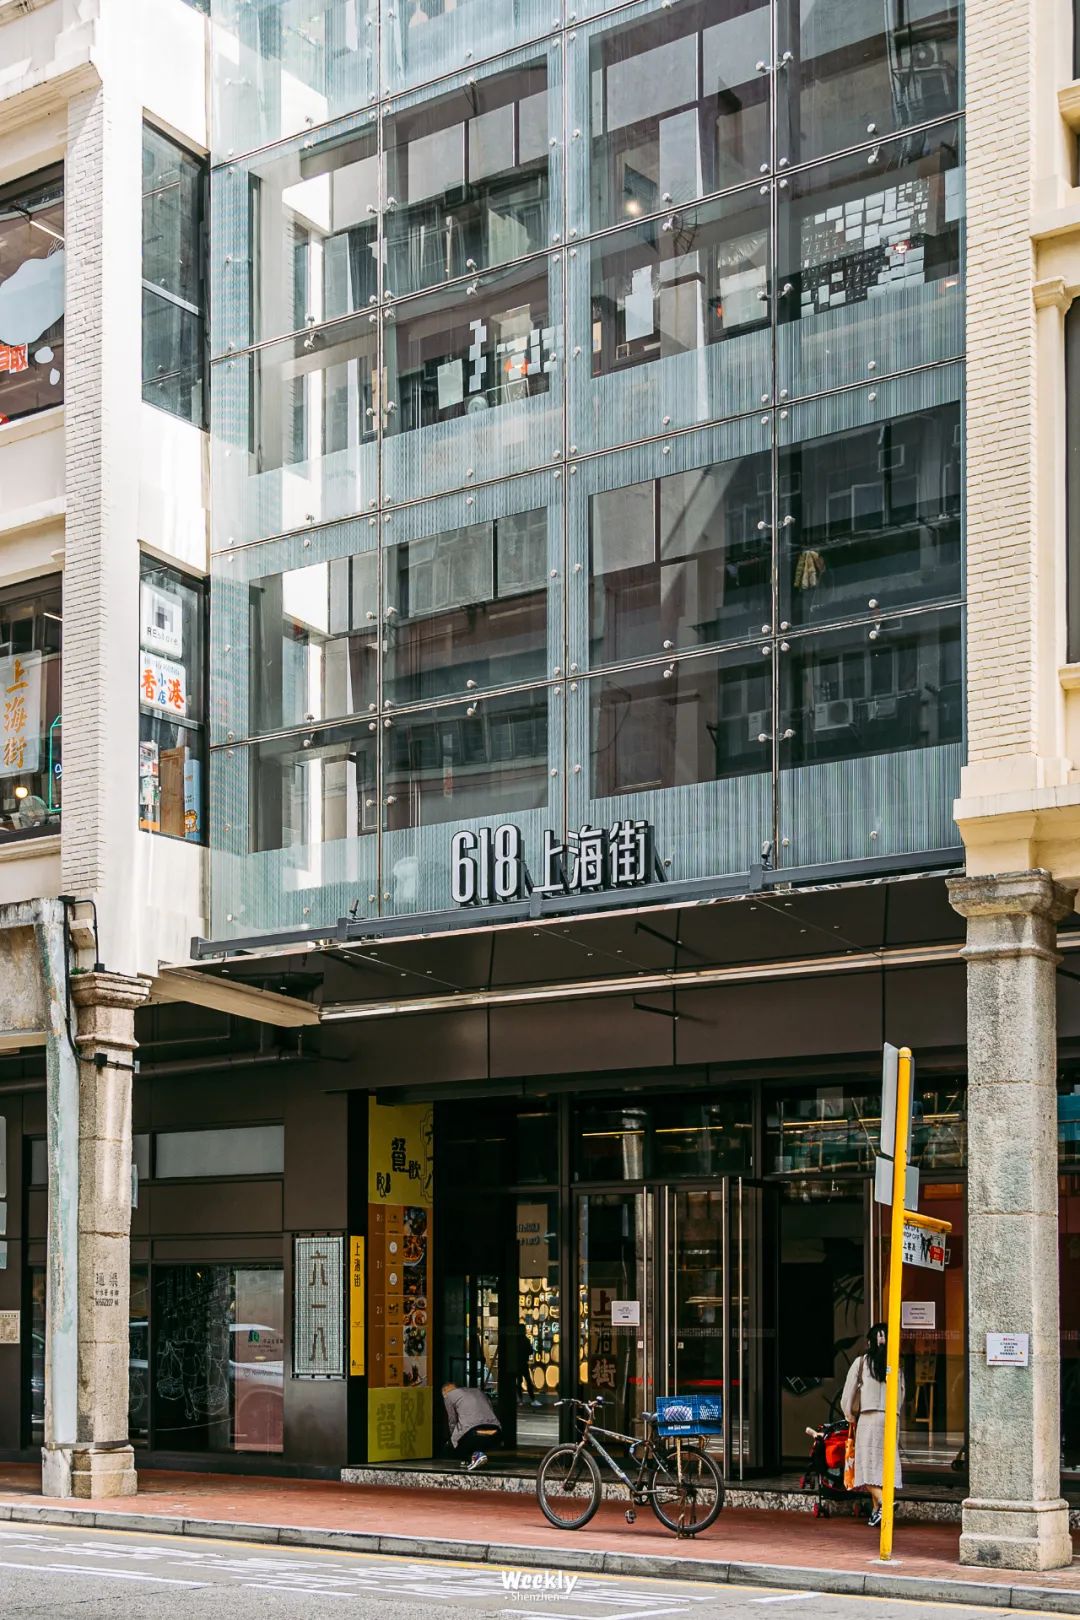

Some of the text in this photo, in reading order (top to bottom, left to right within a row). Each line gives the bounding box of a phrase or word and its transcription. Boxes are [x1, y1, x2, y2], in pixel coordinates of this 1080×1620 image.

[3, 658, 29, 769] 上海街
[451, 819, 652, 903] 618 上海街
[308, 1249, 329, 1362] 六一八
